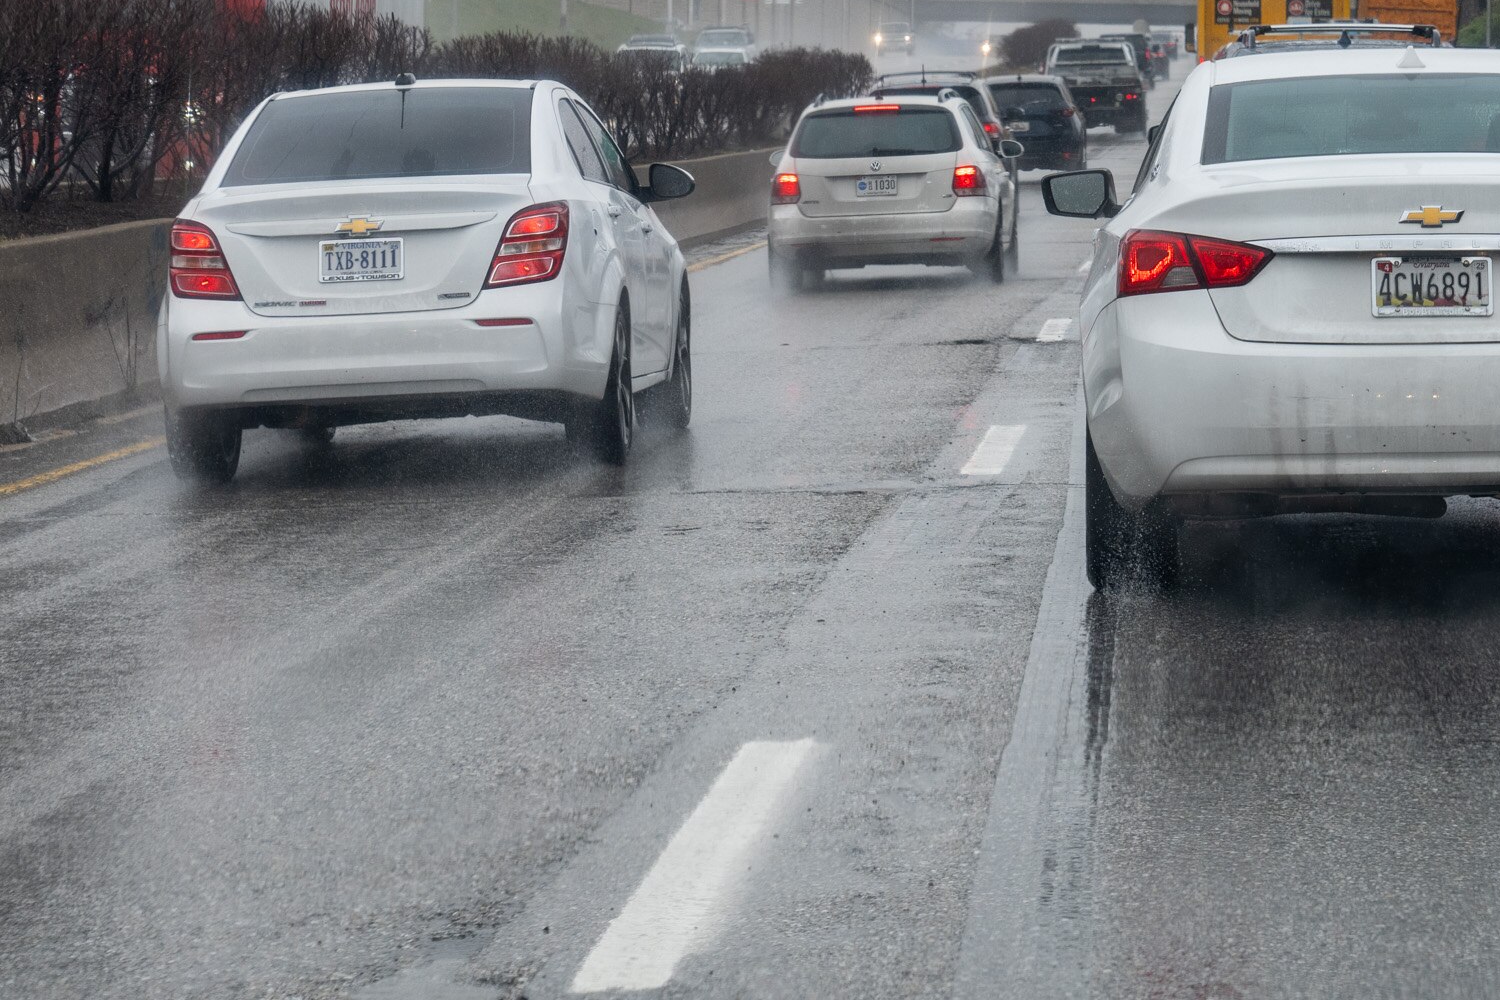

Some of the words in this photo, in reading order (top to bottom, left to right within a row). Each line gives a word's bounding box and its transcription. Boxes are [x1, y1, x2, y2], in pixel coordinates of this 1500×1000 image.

[342, 241, 381, 249] VIRGINIA
[325, 249, 397, 271] TXB-8111
[1380, 271, 1482, 303] 4CW6891
